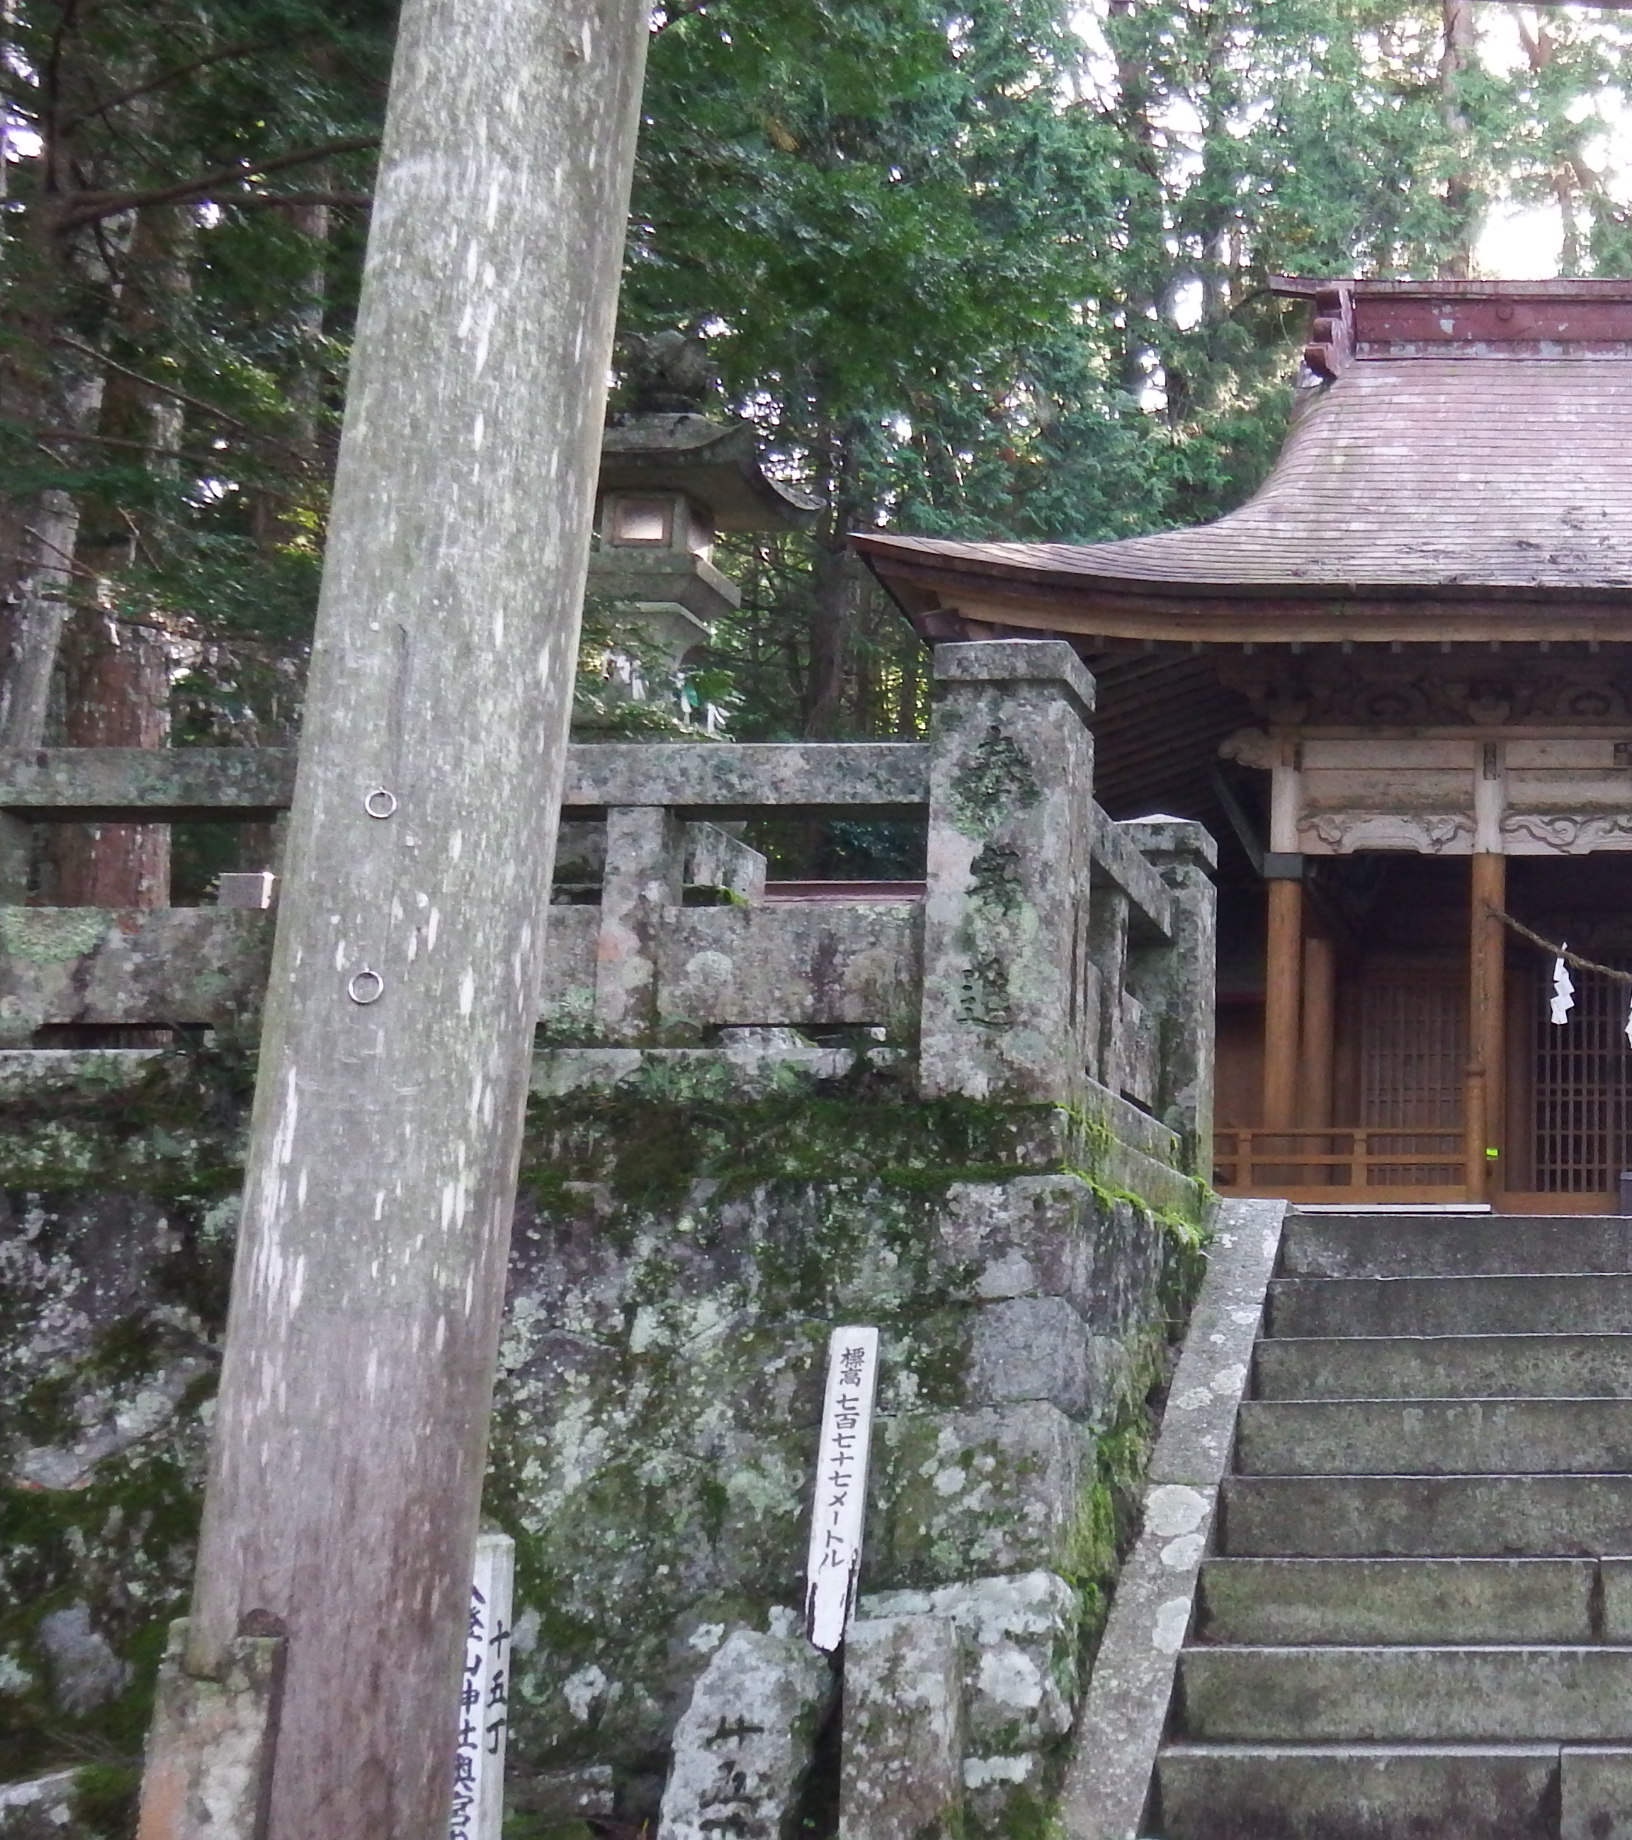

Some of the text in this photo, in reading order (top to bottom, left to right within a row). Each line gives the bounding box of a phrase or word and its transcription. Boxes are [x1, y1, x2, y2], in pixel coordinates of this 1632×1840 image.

[819, 1346, 866, 1568] 標高七百七十七メートル
[486, 1619, 511, 1755] 十五丁
